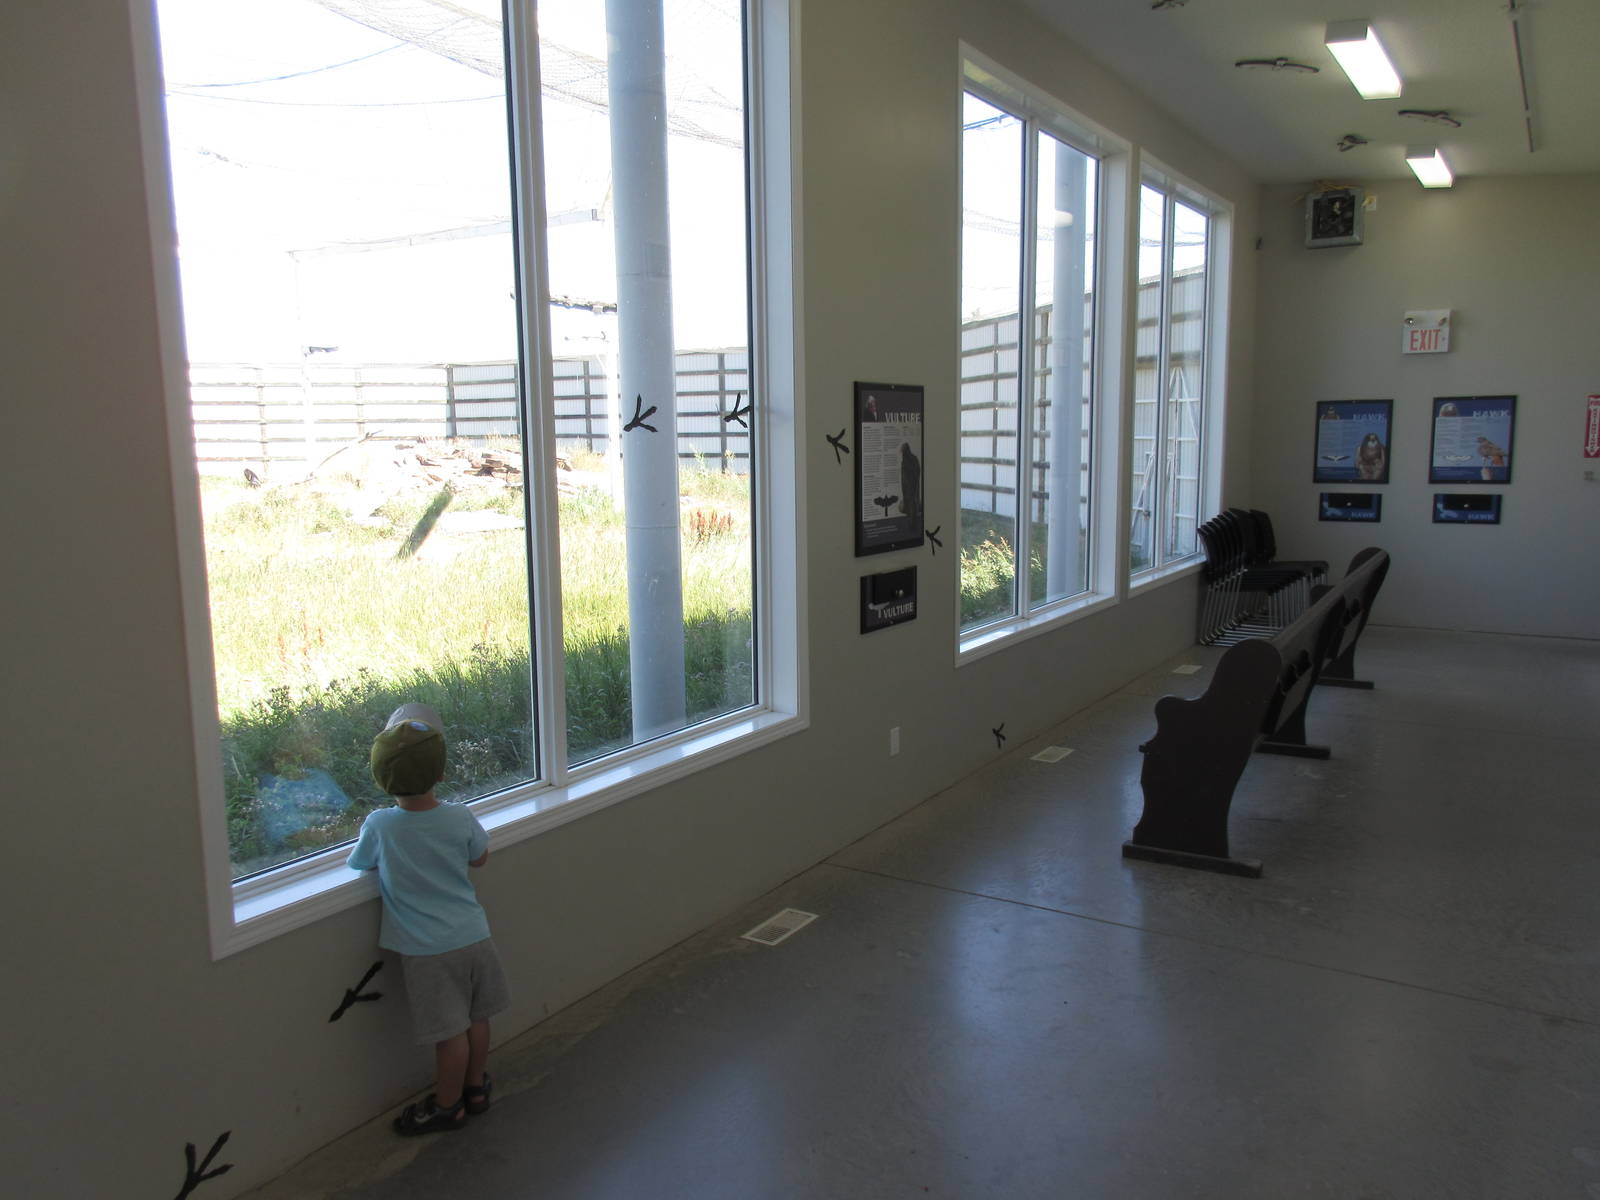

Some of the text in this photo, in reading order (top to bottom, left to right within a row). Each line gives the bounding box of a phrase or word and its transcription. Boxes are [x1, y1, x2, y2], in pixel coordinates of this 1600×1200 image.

[1409, 329, 1440, 351] EXIT
[884, 411, 921, 425] VULTURE
[1352, 413, 1386, 422] HAWK
[1473, 410, 1510, 418] HAWK
[883, 602, 913, 619] VULTURE
